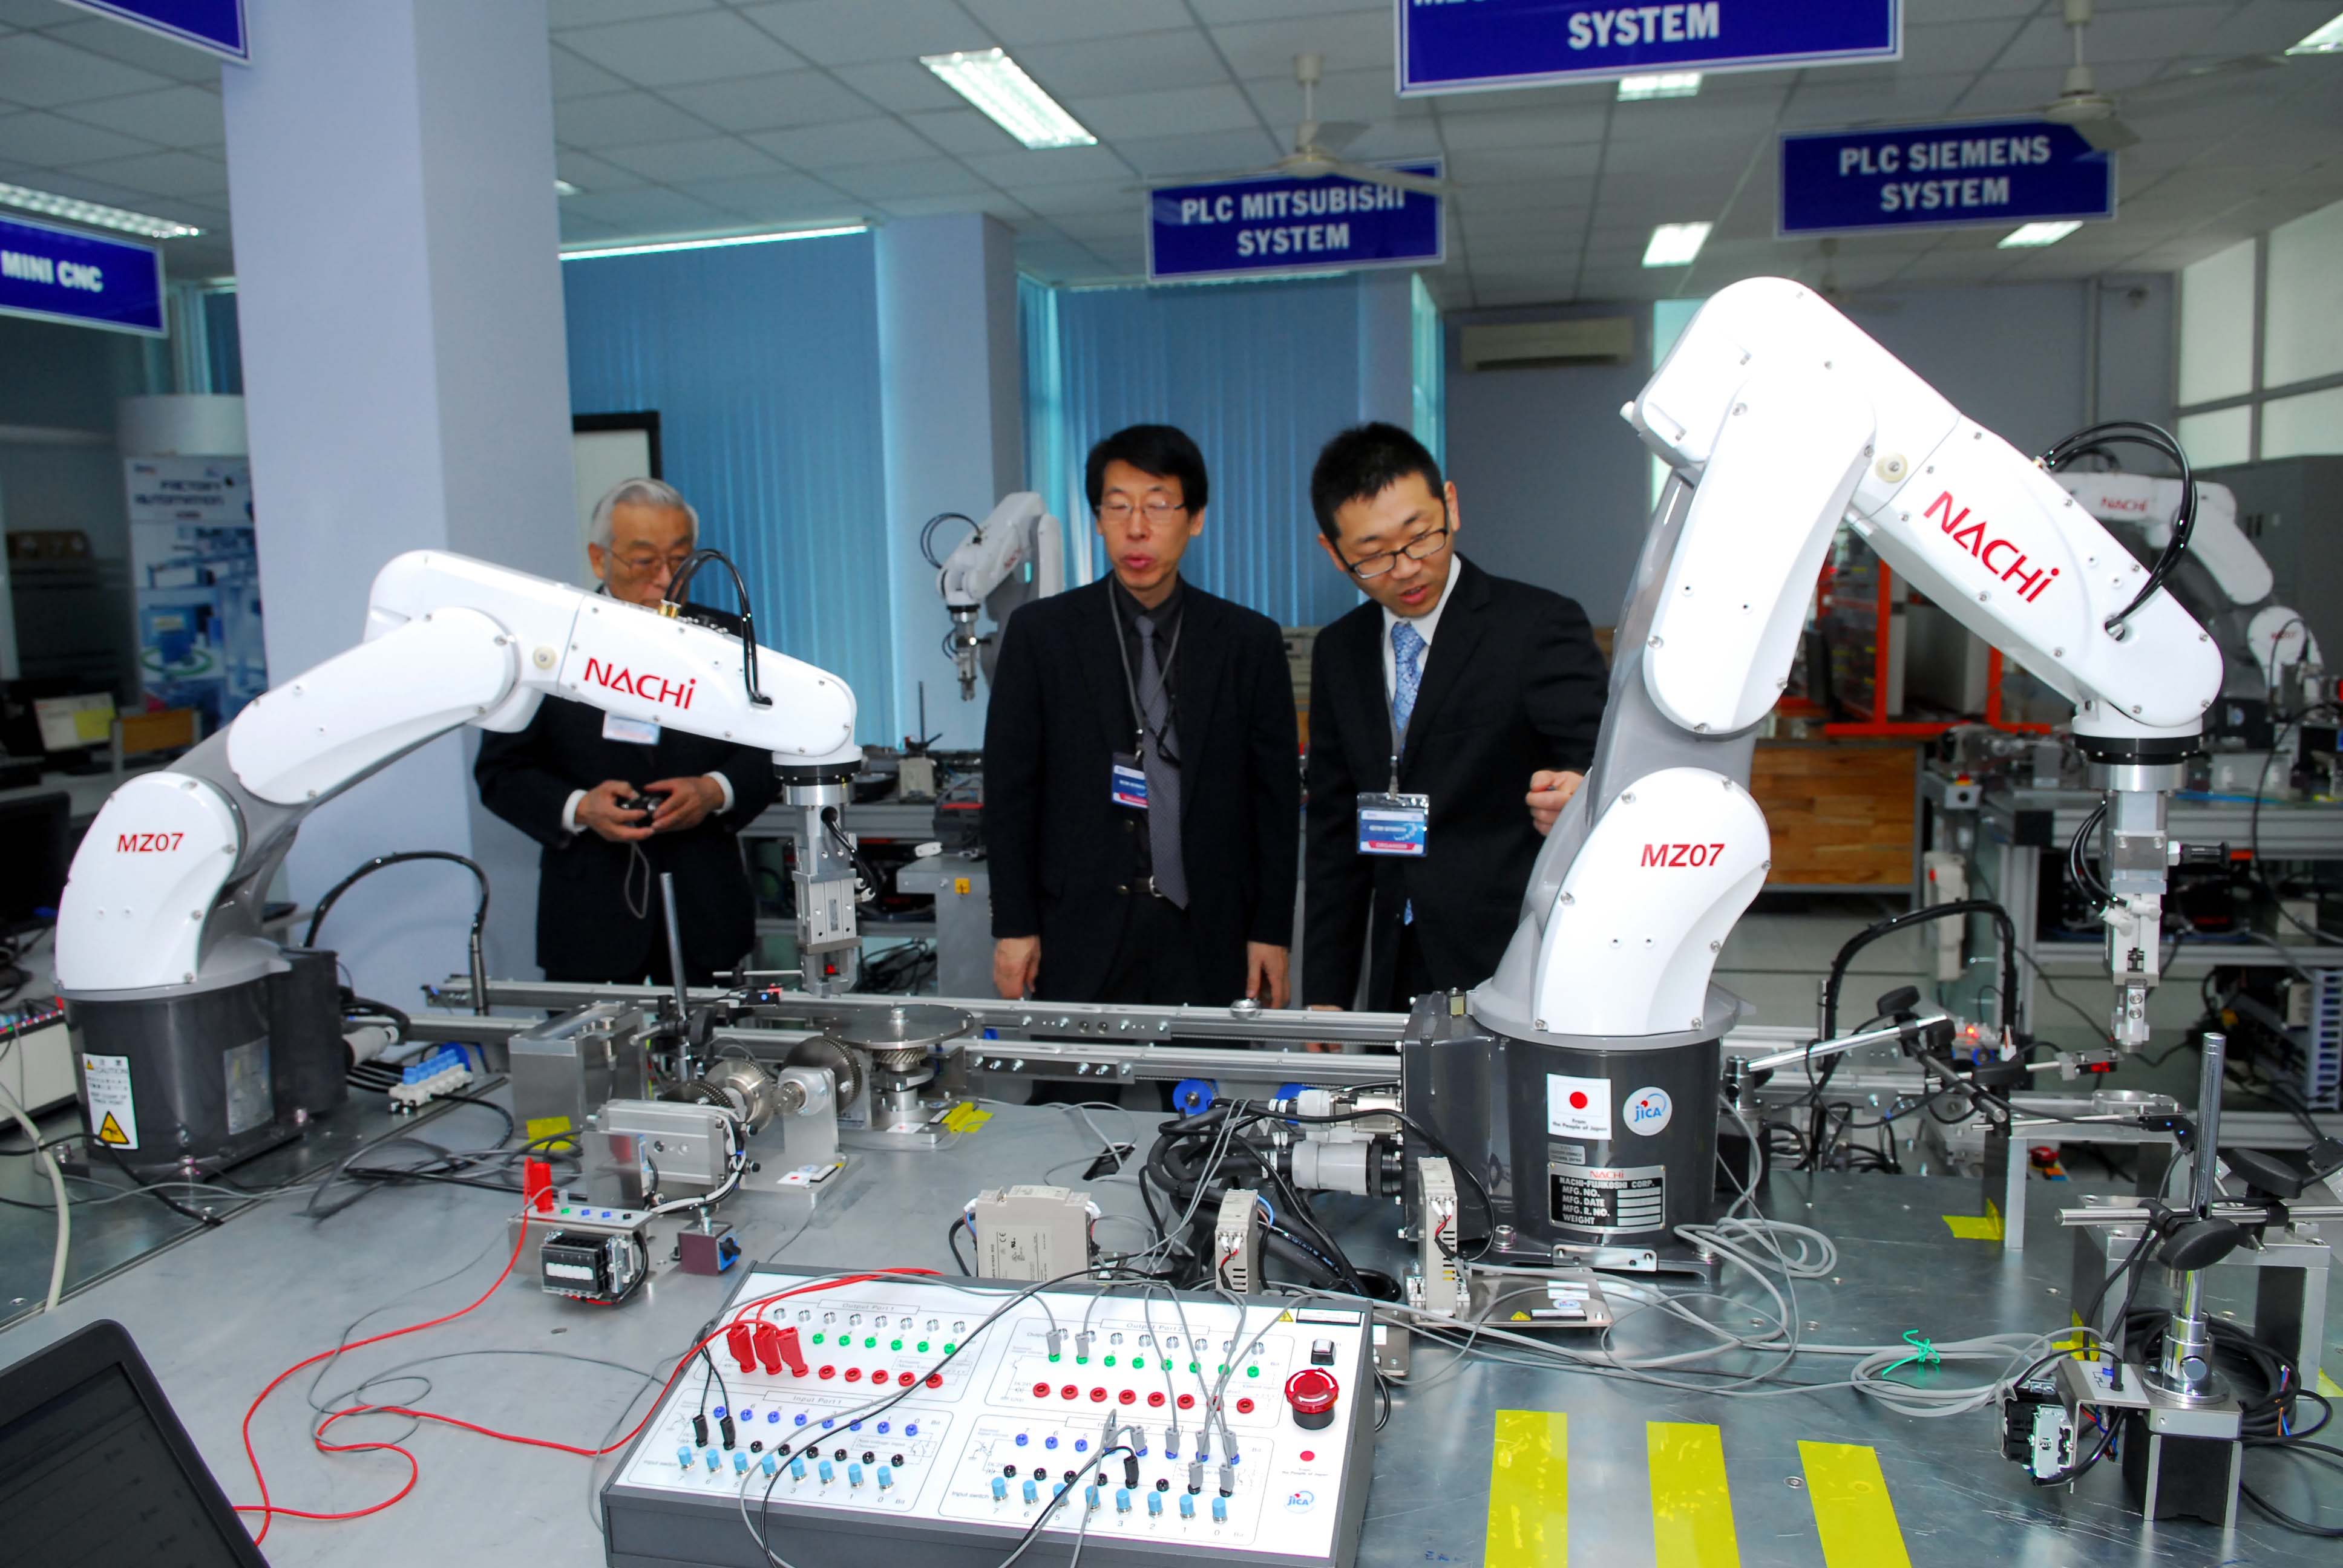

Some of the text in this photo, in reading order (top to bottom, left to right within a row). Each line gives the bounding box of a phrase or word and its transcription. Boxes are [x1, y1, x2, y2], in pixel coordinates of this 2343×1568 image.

[1568, 2, 1720, 51] SYSTEM
[1840, 136, 2051, 177] PLC SIEMENS
[1181, 183, 1406, 224] PLC MITSUBISHI
[1880, 177, 2010, 212] SYSTEM
[1237, 223, 1351, 258] SYSTEM
[1, 250, 104, 293] MINI CNC
[116, 832, 185, 854] MZ07
[1640, 843, 1726, 867] MZ07
[1559, 1177, 1628, 1189] NACHI-FUJIKOSHI
[1562, 1186, 1601, 1197] MFG. NO.
[1562, 1195, 1605, 1207] MFG. DATE
[1562, 1204, 1611, 1217] MFG. R. NO.
[1562, 1214, 1596, 1226] WEIGHT
[1126, 1322, 1155, 1330] Outpt
[793, 1395, 815, 1403] Input
